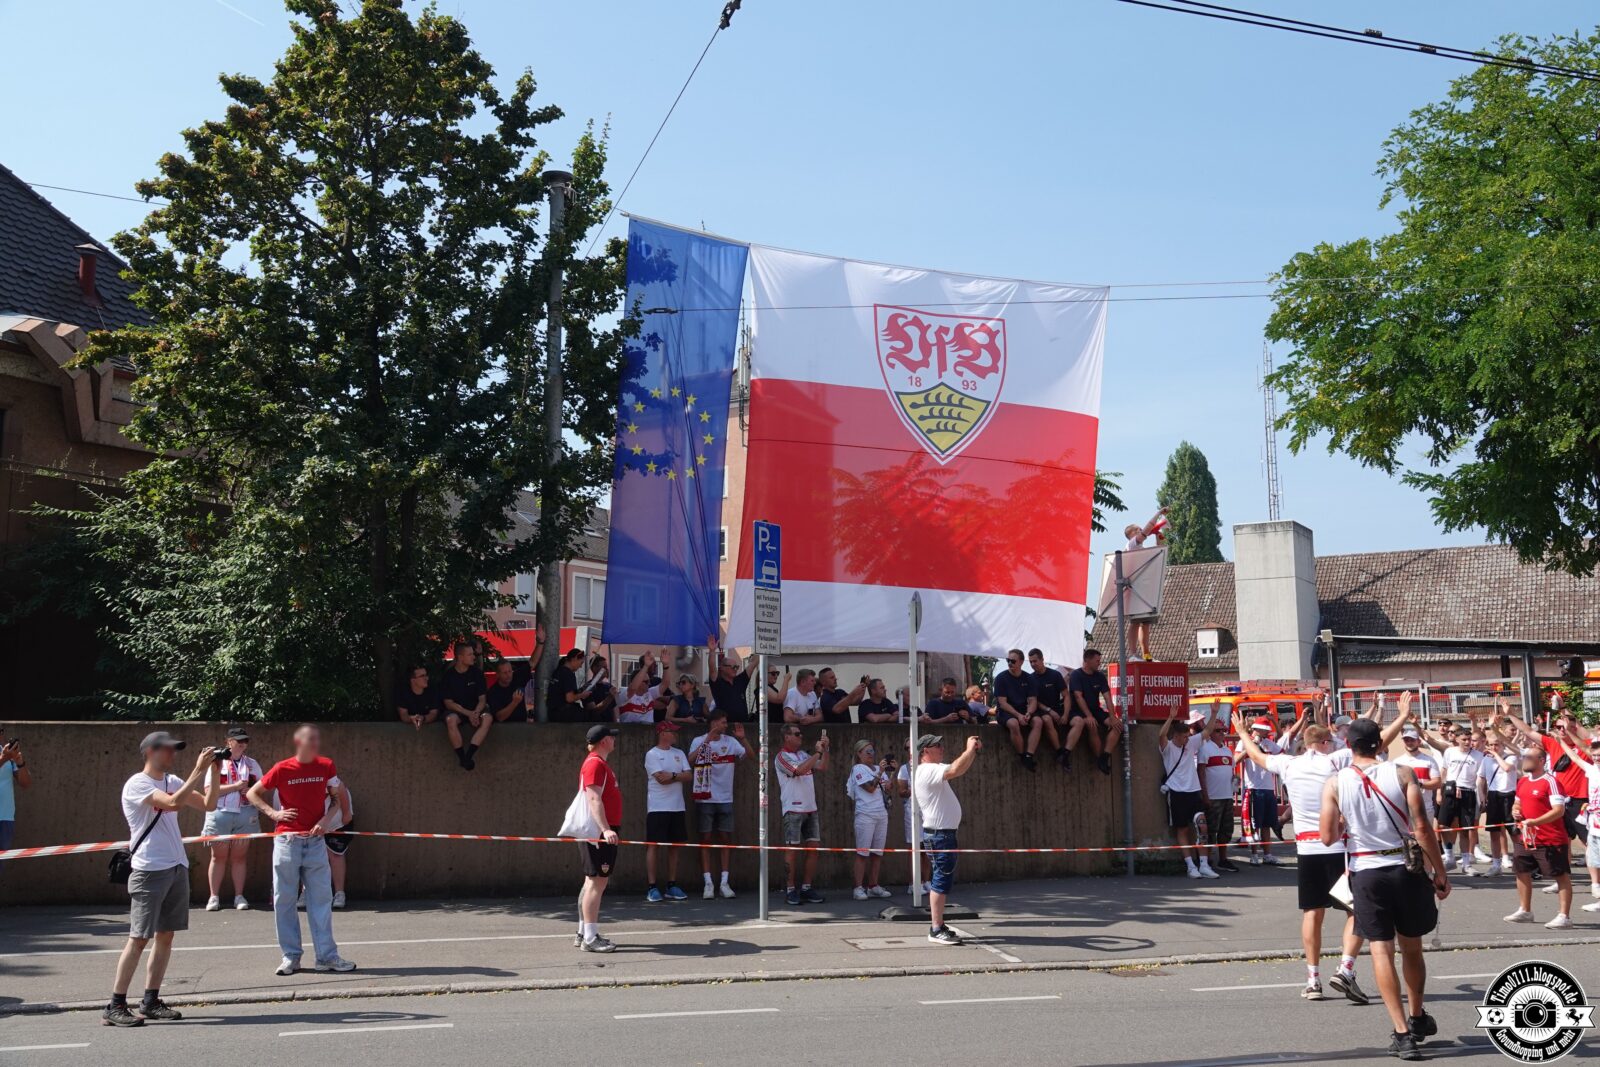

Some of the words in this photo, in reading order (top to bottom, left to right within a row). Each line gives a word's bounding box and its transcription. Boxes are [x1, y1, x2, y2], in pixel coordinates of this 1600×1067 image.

[908, 376, 922, 388] 18
[962, 379, 978, 391] 93
[758, 526, 770, 551] P
[1140, 675, 1185, 688] FEUERWEHR
[1143, 694, 1183, 706] AUSFAHRT
